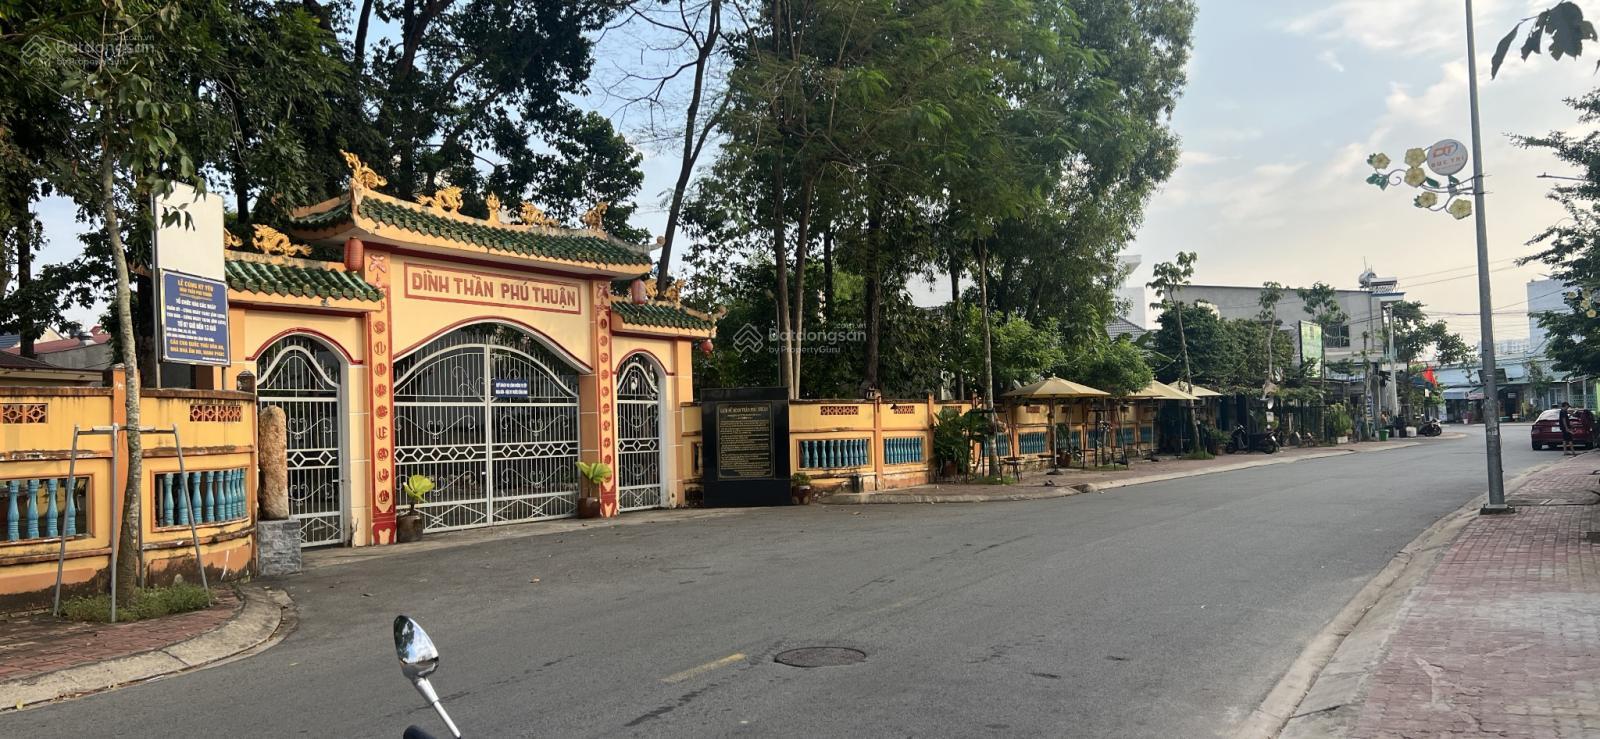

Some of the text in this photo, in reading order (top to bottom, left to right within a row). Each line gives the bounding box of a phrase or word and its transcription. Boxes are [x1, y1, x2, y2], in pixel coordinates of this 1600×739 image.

[453, 274, 494, 298] THẦN
[501, 281, 529, 301] PHÚ
[532, 285, 576, 309] THUẬN
